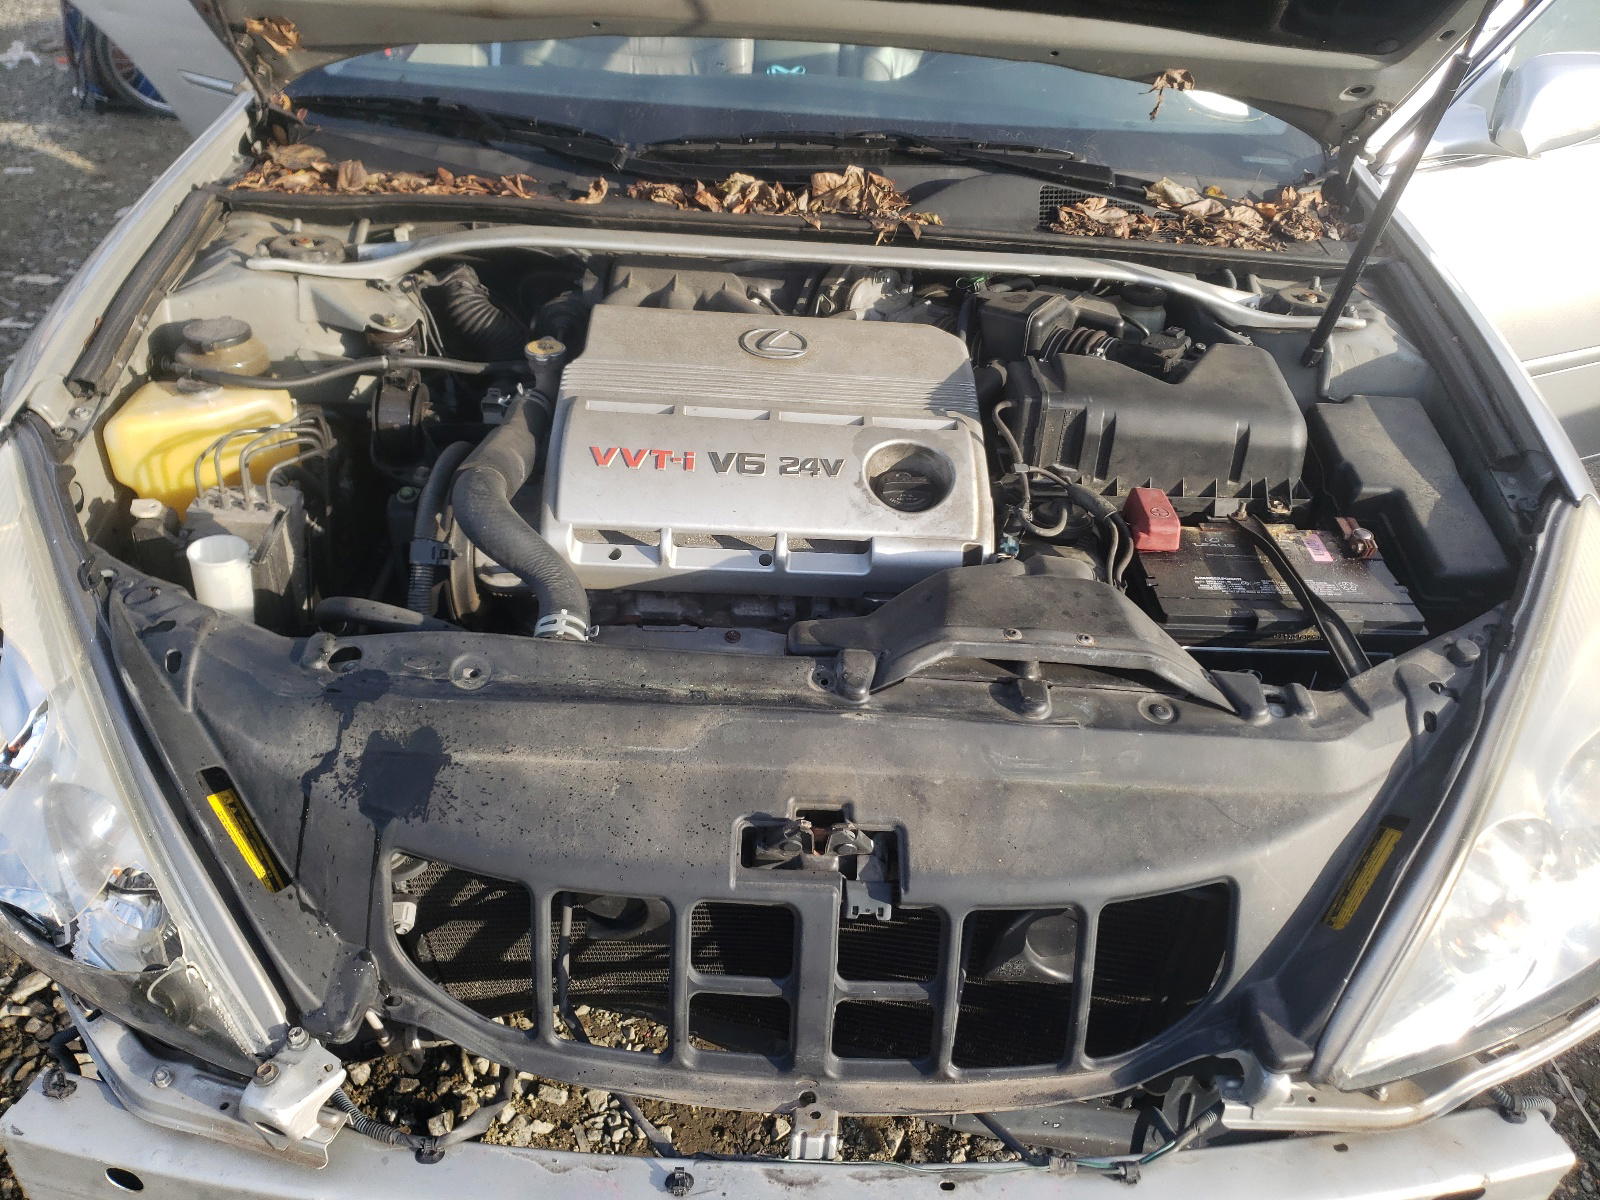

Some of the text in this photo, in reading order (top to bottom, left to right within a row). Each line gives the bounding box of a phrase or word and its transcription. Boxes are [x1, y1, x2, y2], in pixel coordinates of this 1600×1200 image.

[589, 446, 846, 478] VVT-i V6 24V
